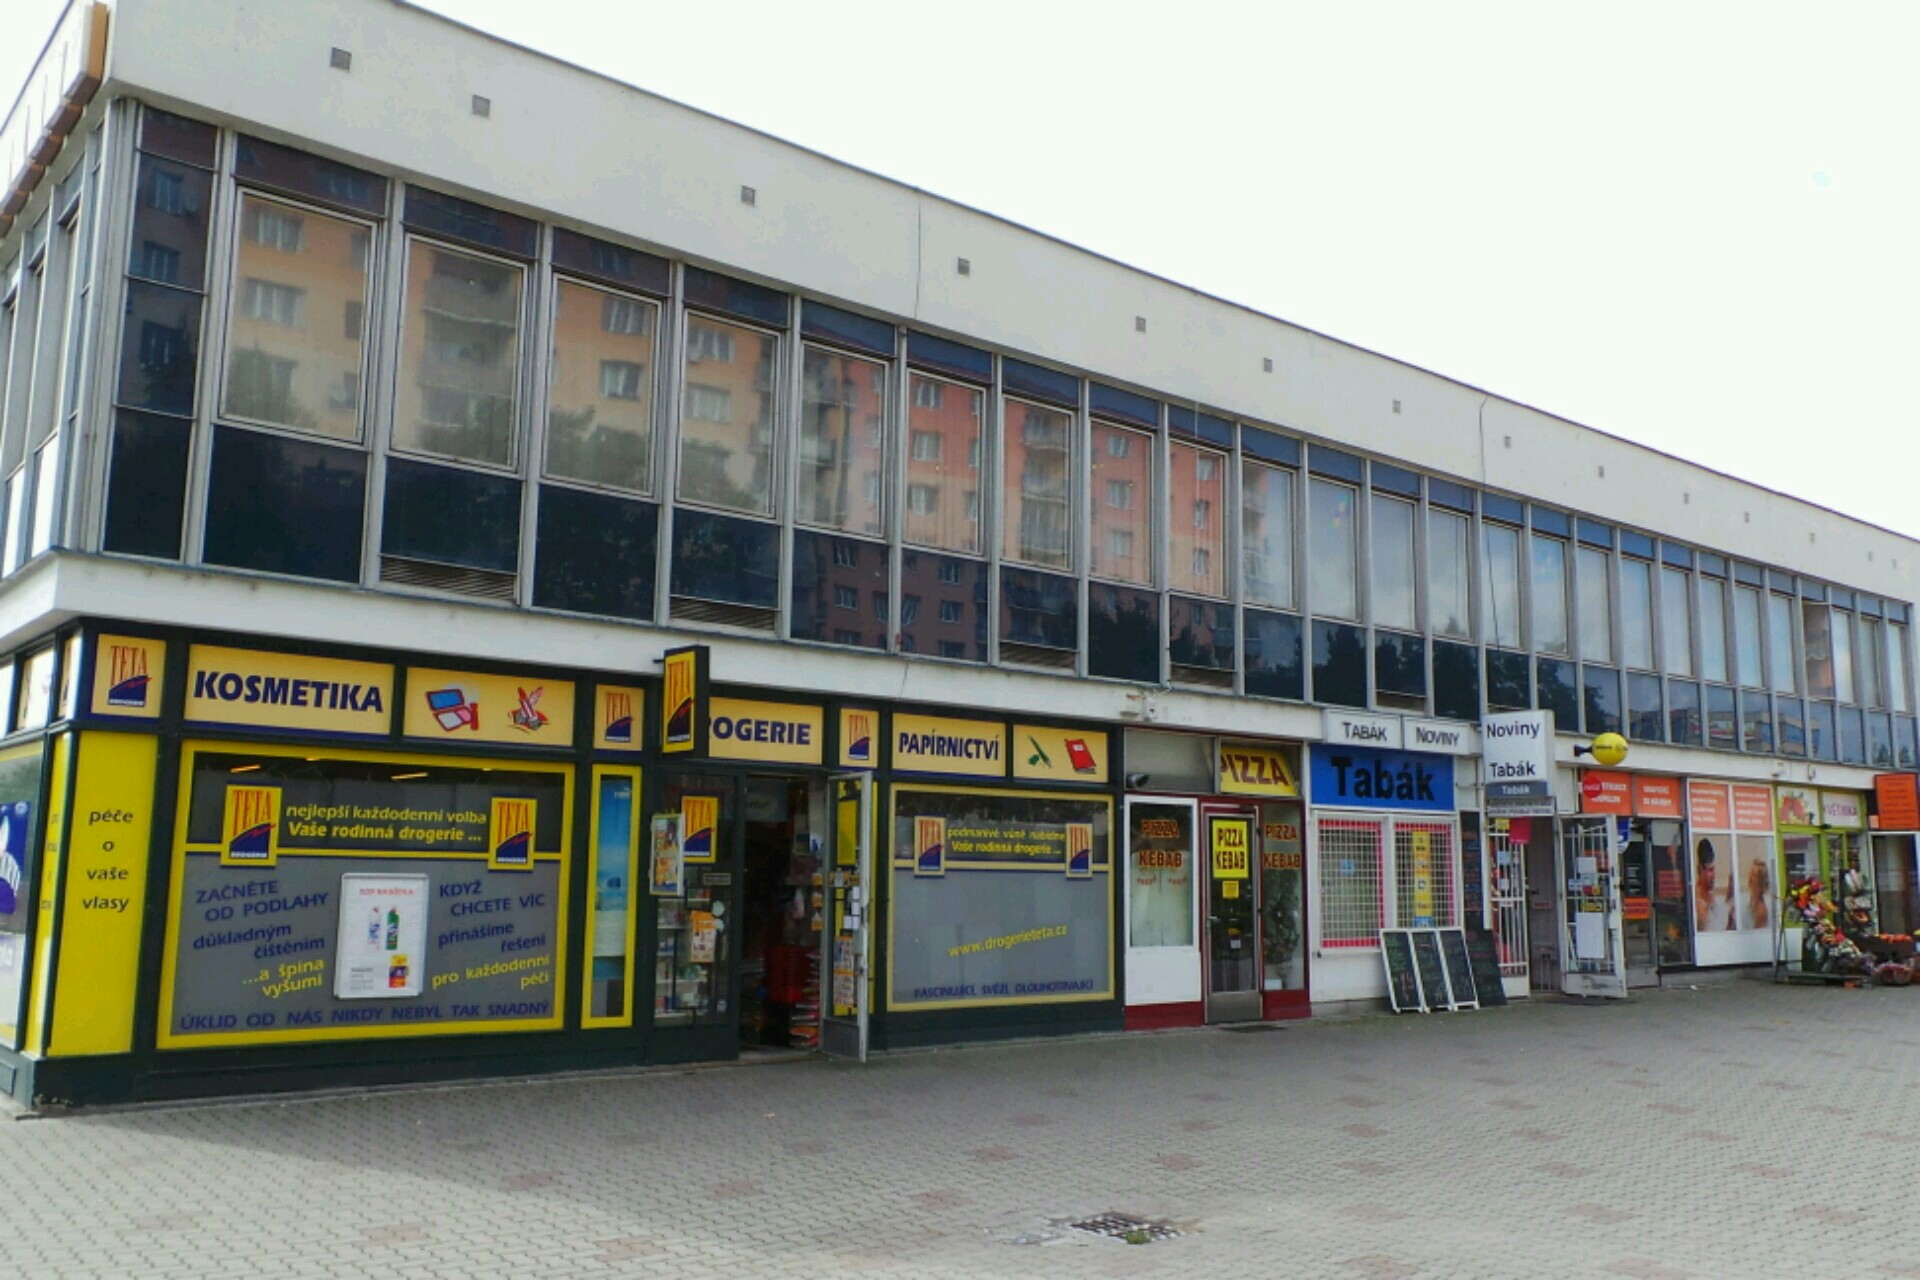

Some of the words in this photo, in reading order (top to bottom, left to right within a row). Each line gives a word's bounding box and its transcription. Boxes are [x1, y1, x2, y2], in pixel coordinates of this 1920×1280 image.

[110, 645, 147, 687] TETA
[194, 671, 383, 713] KOSMETIKA
[709, 716, 811, 745] OGERIE
[1343, 721, 1387, 741] TABÁK
[1416, 727, 1460, 747] NOVINY
[1487, 721, 1540, 739] Noviny
[899, 728, 999, 760] PAPÍRNICTVÍ
[1331, 757, 1435, 801] Tabák
[1490, 761, 1536, 778] Tabák
[1502, 785, 1530, 795] Tabák
[89, 810, 133, 825] péče
[233, 790, 271, 836] TETA
[286, 804, 350, 821] nejlepší
[353, 805, 443, 822] každodenní
[446, 811, 487, 824] volba
[288, 821, 327, 837] Vaše
[332, 822, 393, 839] rodinná
[399, 826, 464, 844] drogerie
[1217, 827, 1244, 848] PIZZA
[1265, 825, 1297, 840] PIZZA
[102, 841, 114, 851] o
[952, 840, 974, 851] Vaše
[1139, 850, 1182, 868] KEBAB
[1216, 851, 1245, 870] KEBAB
[1264, 853, 1300, 869] KEBAB
[86, 867, 129, 880] vaše
[196, 880, 279, 904] ZAČNĚTE
[440, 880, 482, 898] KDYŽ
[82, 896, 129, 912] vlasy
[205, 906, 234, 921] OD
[244, 893, 328, 917] PODLAHY
[450, 898, 511, 916] CHCETE
[519, 893, 545, 909] VÍC
[193, 923, 291, 949] důkladným
[438, 922, 514, 949] přinášíme
[501, 933, 546, 953] řešení
[254, 937, 325, 959] čištěním
[432, 971, 459, 990] pro
[466, 953, 550, 980] každodenní
[521, 970, 549, 991] péči
[181, 1012, 237, 1030] ÚKLID
[246, 1012, 275, 1027] OD
[287, 1008, 323, 1025] NÁS
[331, 1008, 383, 1021] NIKDY
[391, 1005, 443, 1019] NEBYL
[450, 1004, 480, 1016] TAK
